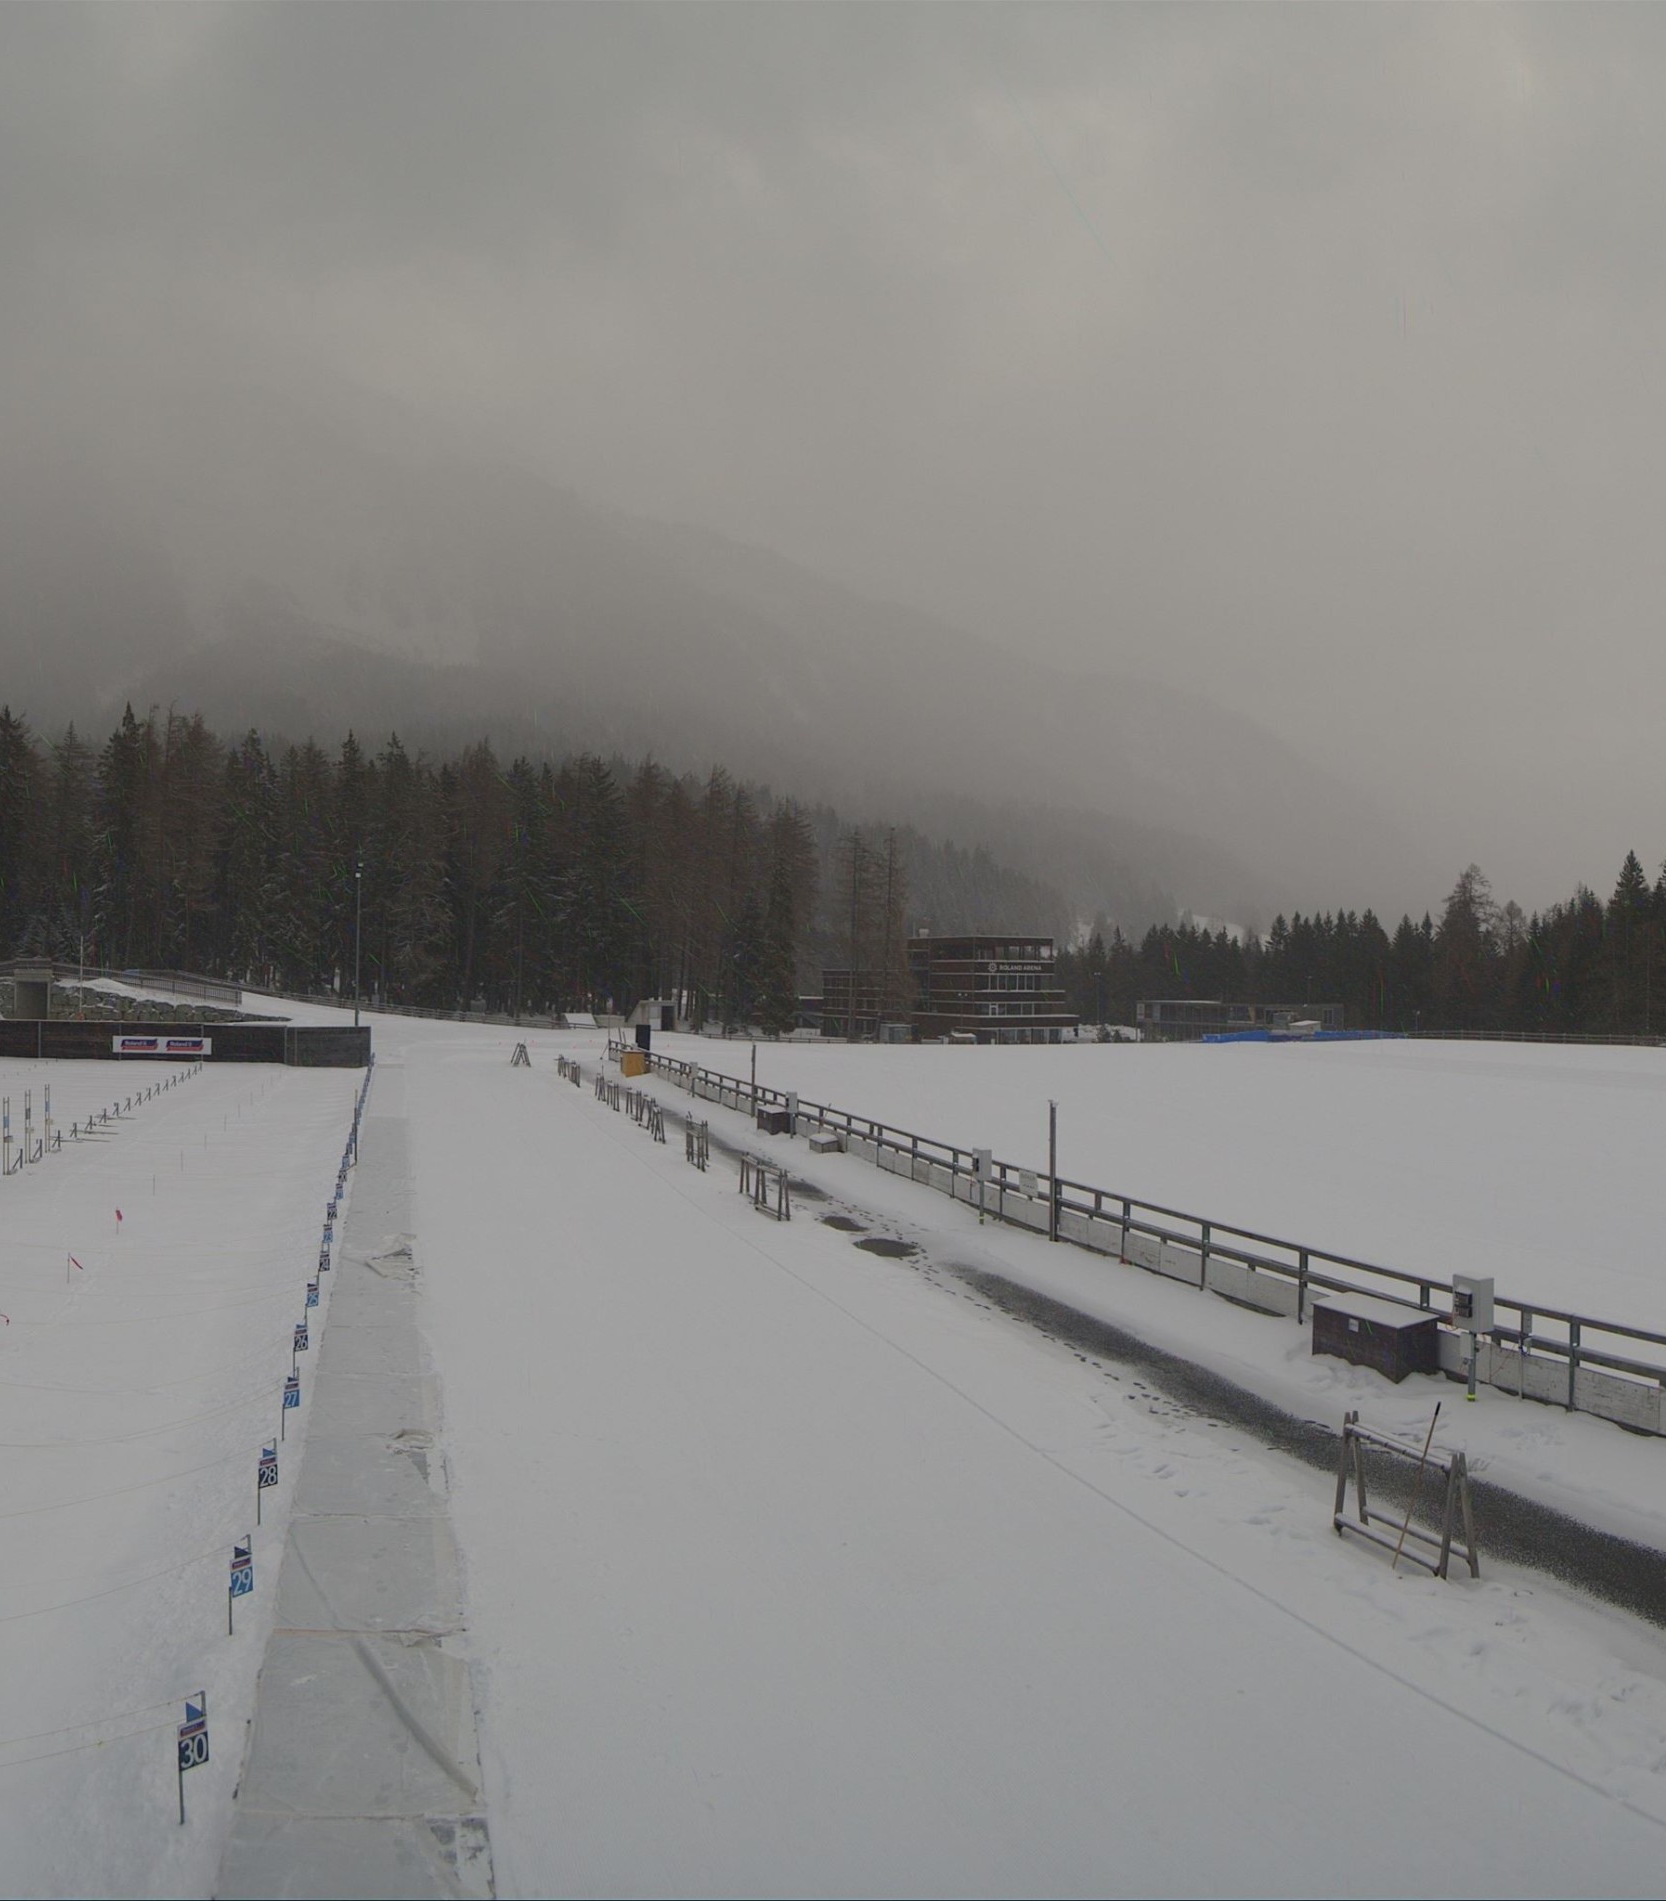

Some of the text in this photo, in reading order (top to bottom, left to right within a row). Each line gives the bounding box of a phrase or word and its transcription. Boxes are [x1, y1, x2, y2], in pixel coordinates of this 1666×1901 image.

[307, 1293, 319, 1306] 25
[295, 1335, 308, 1351] 26
[284, 1391, 299, 1408] 27
[259, 1466, 278, 1488] 28
[232, 1568, 252, 1595] 29
[180, 1733, 207, 1769] 30
